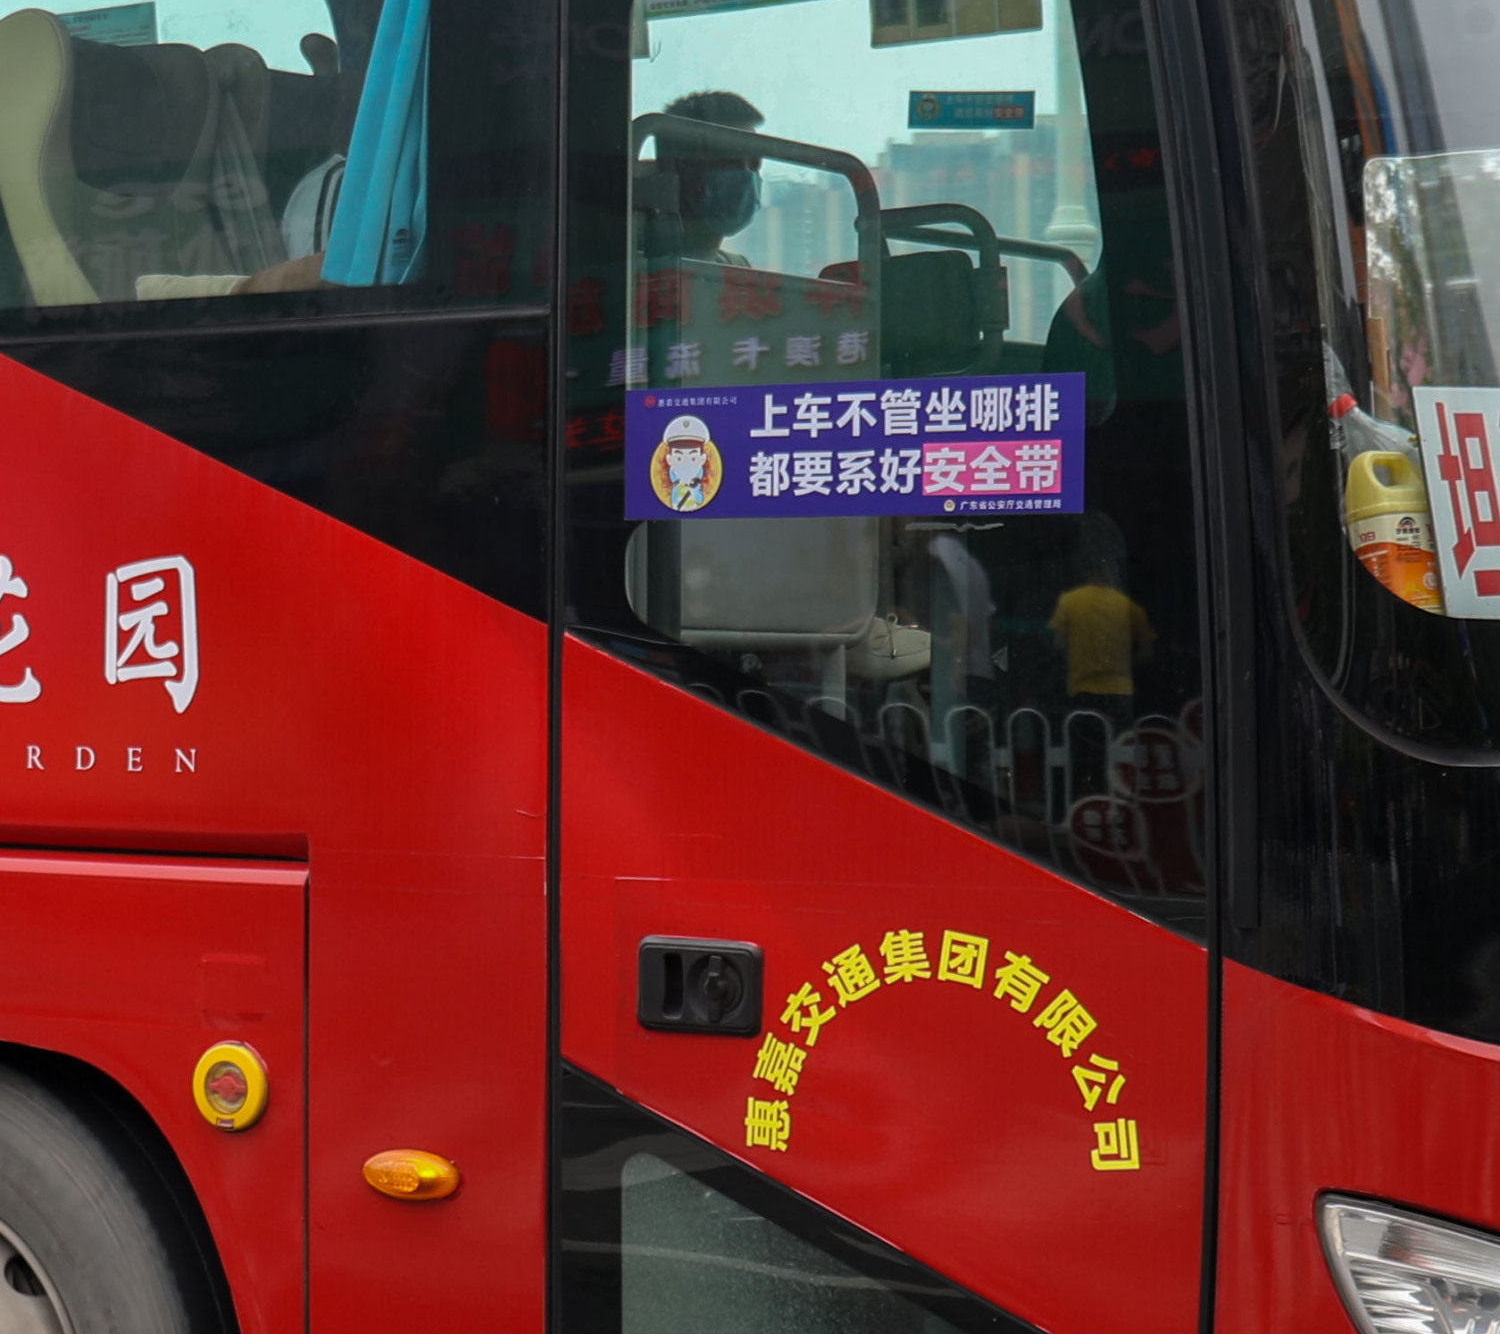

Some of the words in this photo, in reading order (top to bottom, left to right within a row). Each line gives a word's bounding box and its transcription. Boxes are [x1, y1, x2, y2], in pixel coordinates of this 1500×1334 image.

[749, 384, 1060, 438] 上车不管坐哪排
[749, 444, 1060, 496] 都要系好安全带
[960, 499, 1062, 511] 广东省公安厅交通管理局
[744, 929, 1140, 1171] 惠嘉交通集团有限公司
